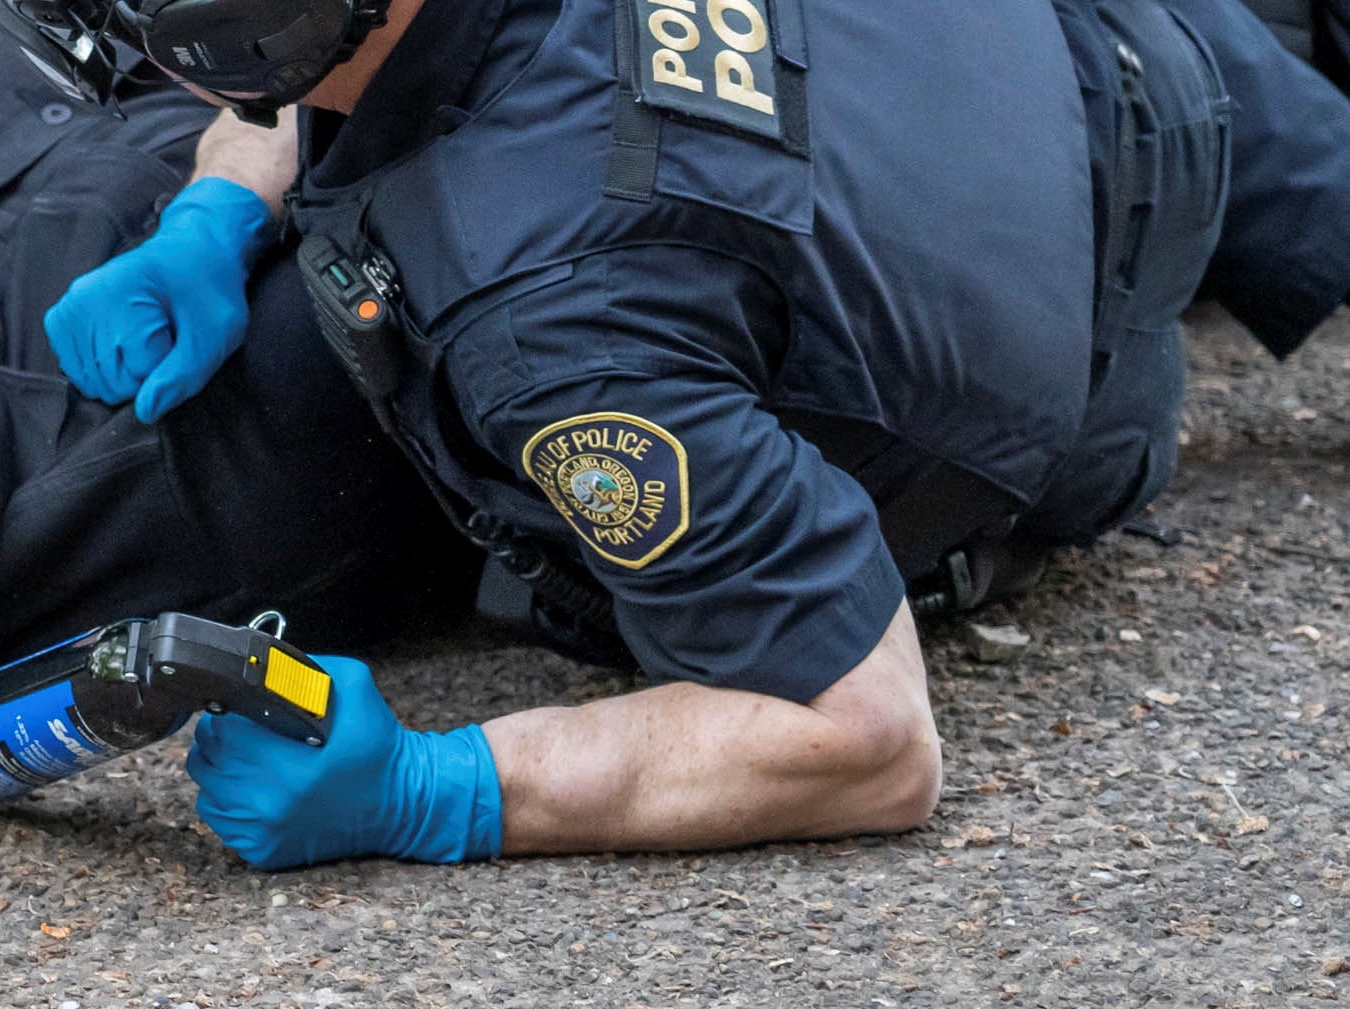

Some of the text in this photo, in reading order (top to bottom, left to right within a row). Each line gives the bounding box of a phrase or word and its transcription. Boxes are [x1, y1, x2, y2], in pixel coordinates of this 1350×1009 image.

[546, 435, 571, 459] OF
[571, 428, 653, 461] POLICE
[601, 459, 635, 501] OREGON
[593, 480, 666, 545] PORTLAND
